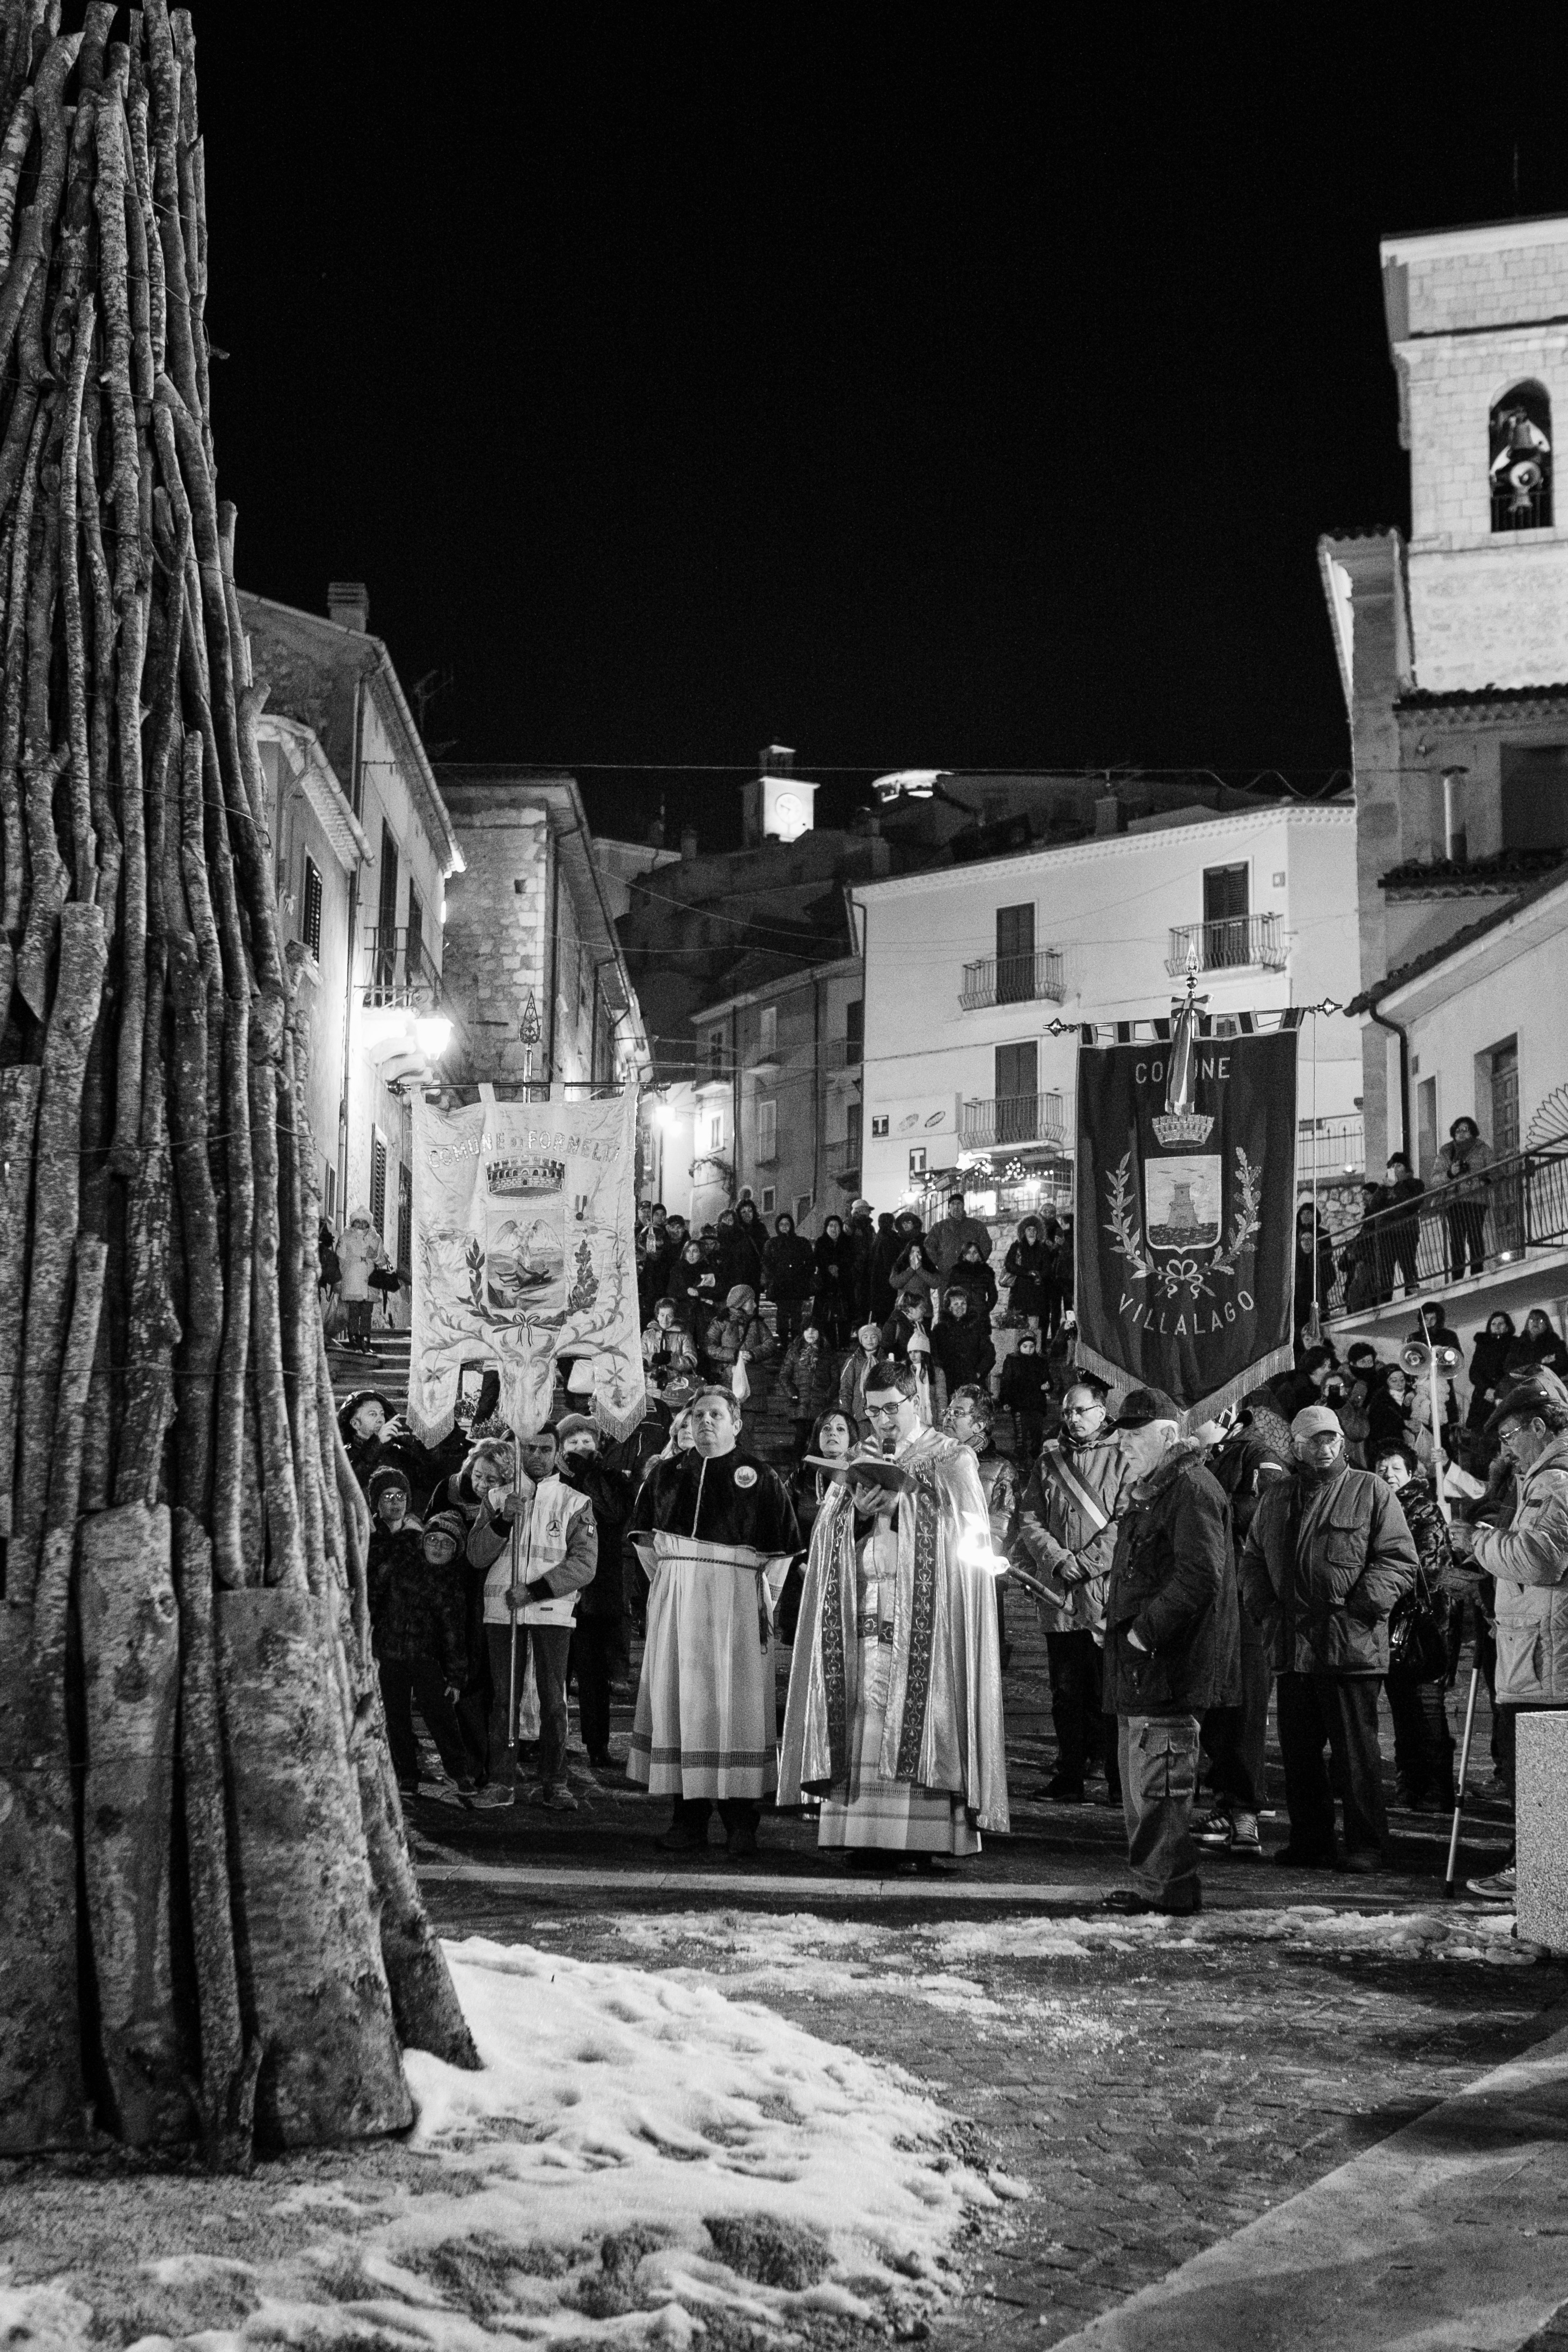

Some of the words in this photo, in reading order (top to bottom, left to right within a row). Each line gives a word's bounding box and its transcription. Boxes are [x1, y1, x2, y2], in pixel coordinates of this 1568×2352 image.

[1135, 1057, 1230, 1084] CONE
[873, 1116, 888, 1133] T
[429, 1132, 505, 1168] COMUNE
[911, 1149, 925, 1173] T
[1119, 1291, 1254, 1336] VILLALAGO
